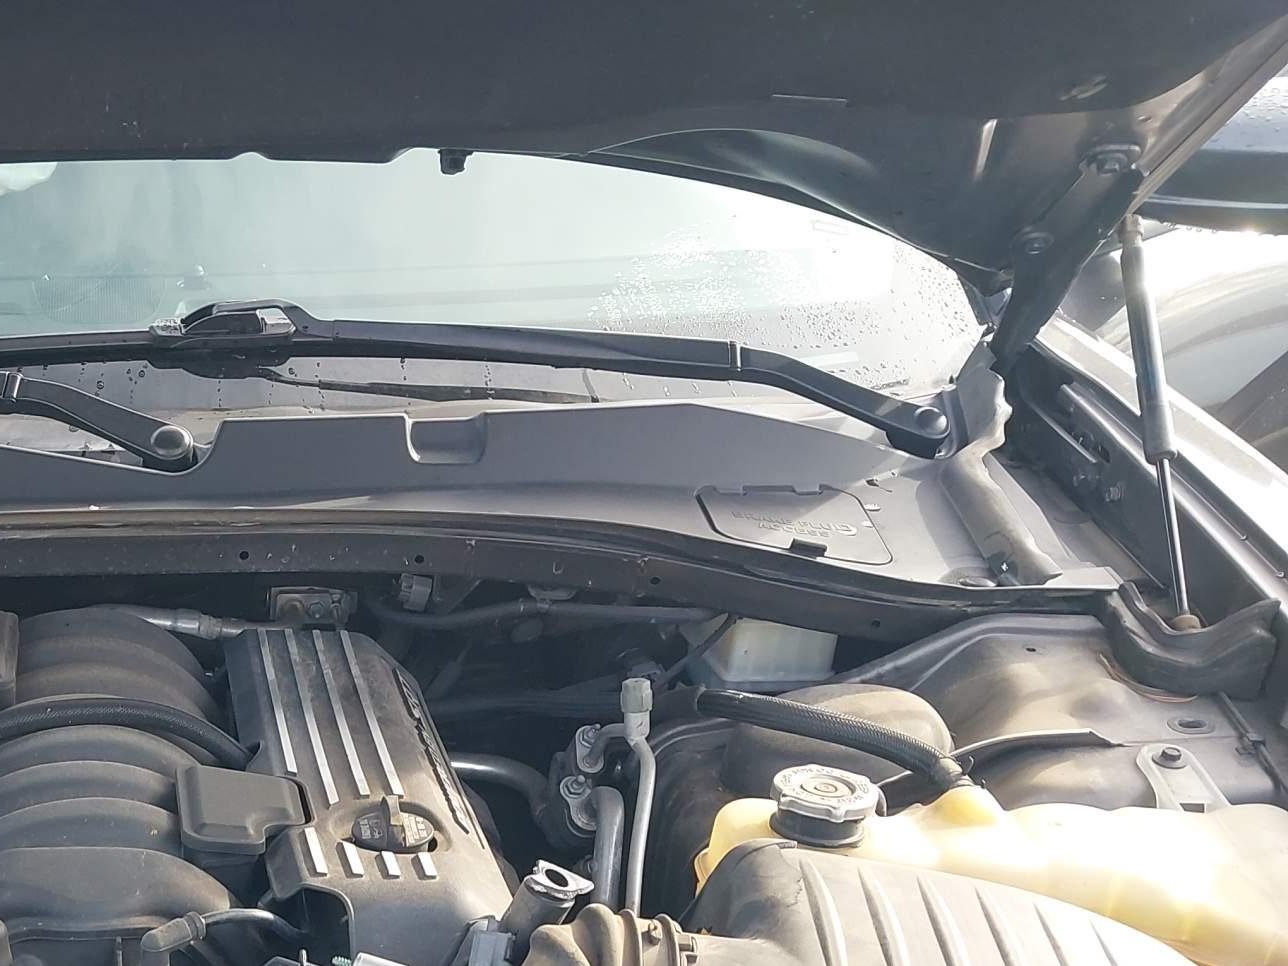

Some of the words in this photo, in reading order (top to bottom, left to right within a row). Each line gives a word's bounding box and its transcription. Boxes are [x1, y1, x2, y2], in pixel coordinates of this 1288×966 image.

[731, 511, 793, 525] BRAKE
[796, 520, 858, 536] FLUID
[758, 522, 830, 538] ACCESS
